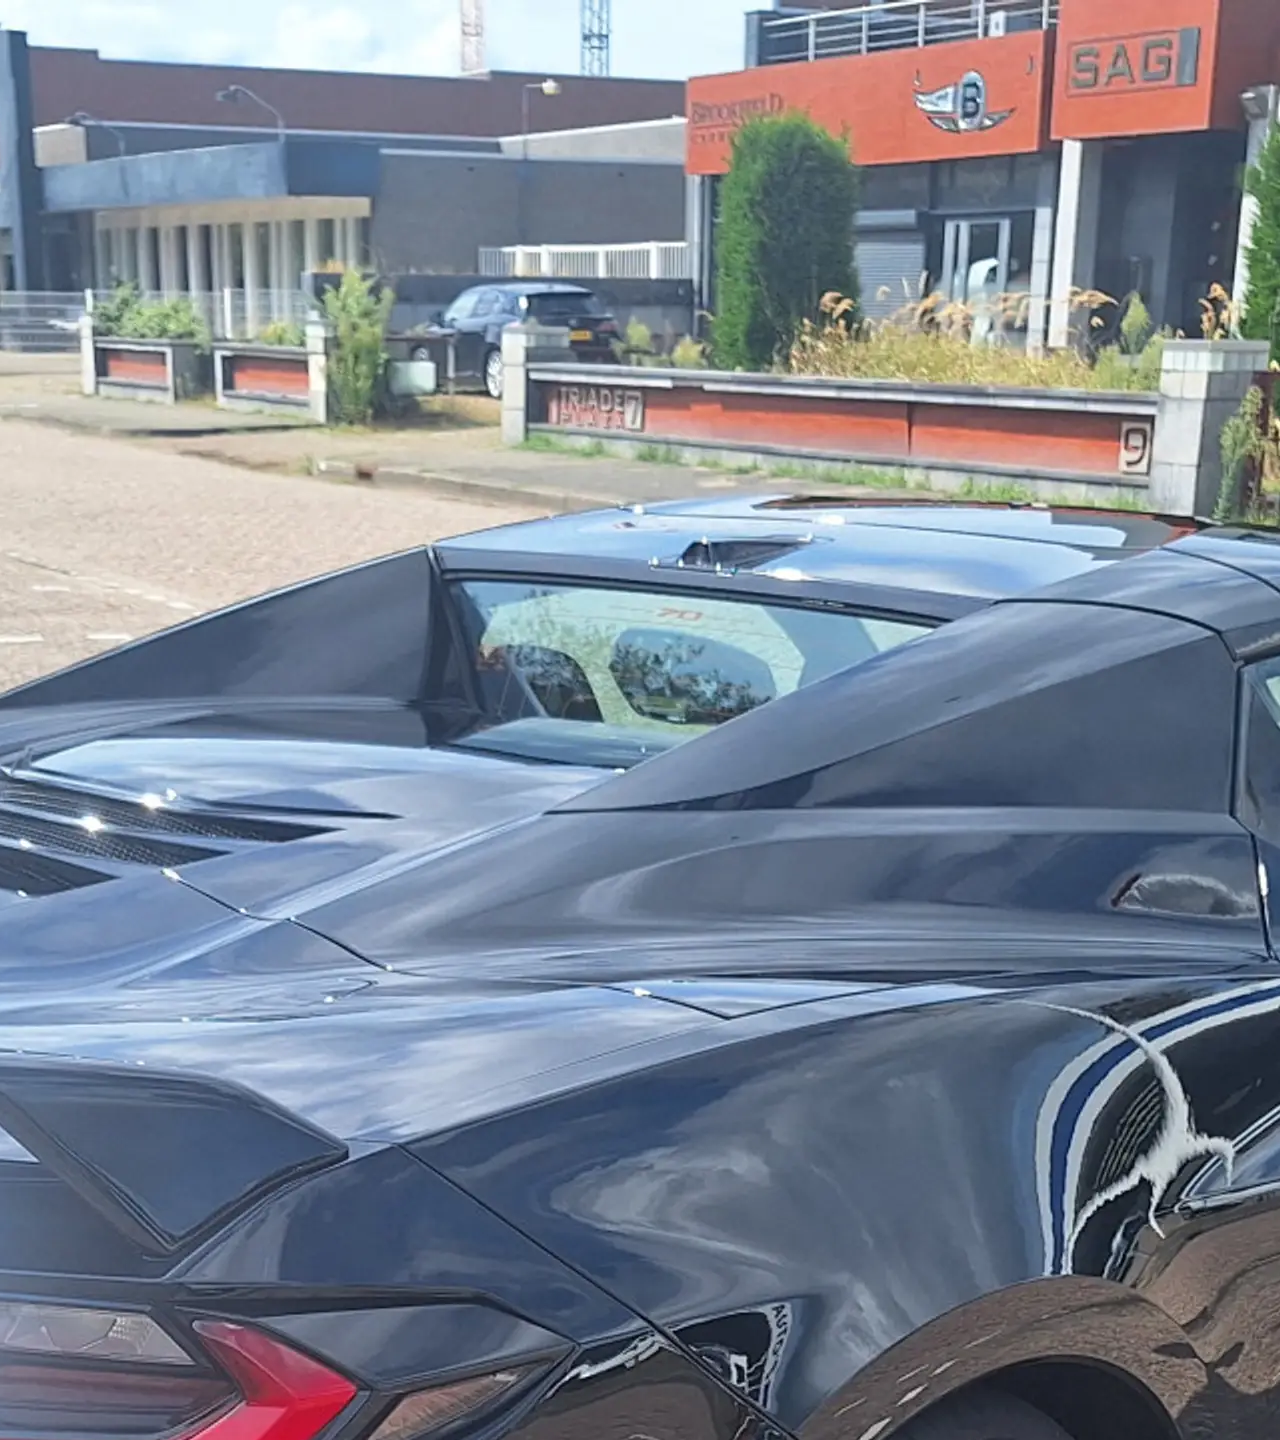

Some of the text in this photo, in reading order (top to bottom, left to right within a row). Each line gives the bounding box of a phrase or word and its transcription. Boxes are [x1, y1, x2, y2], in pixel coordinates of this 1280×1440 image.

[1070, 38, 1173, 88] SAG
[626, 393, 641, 426] 7
[1124, 427, 1147, 467] 9
